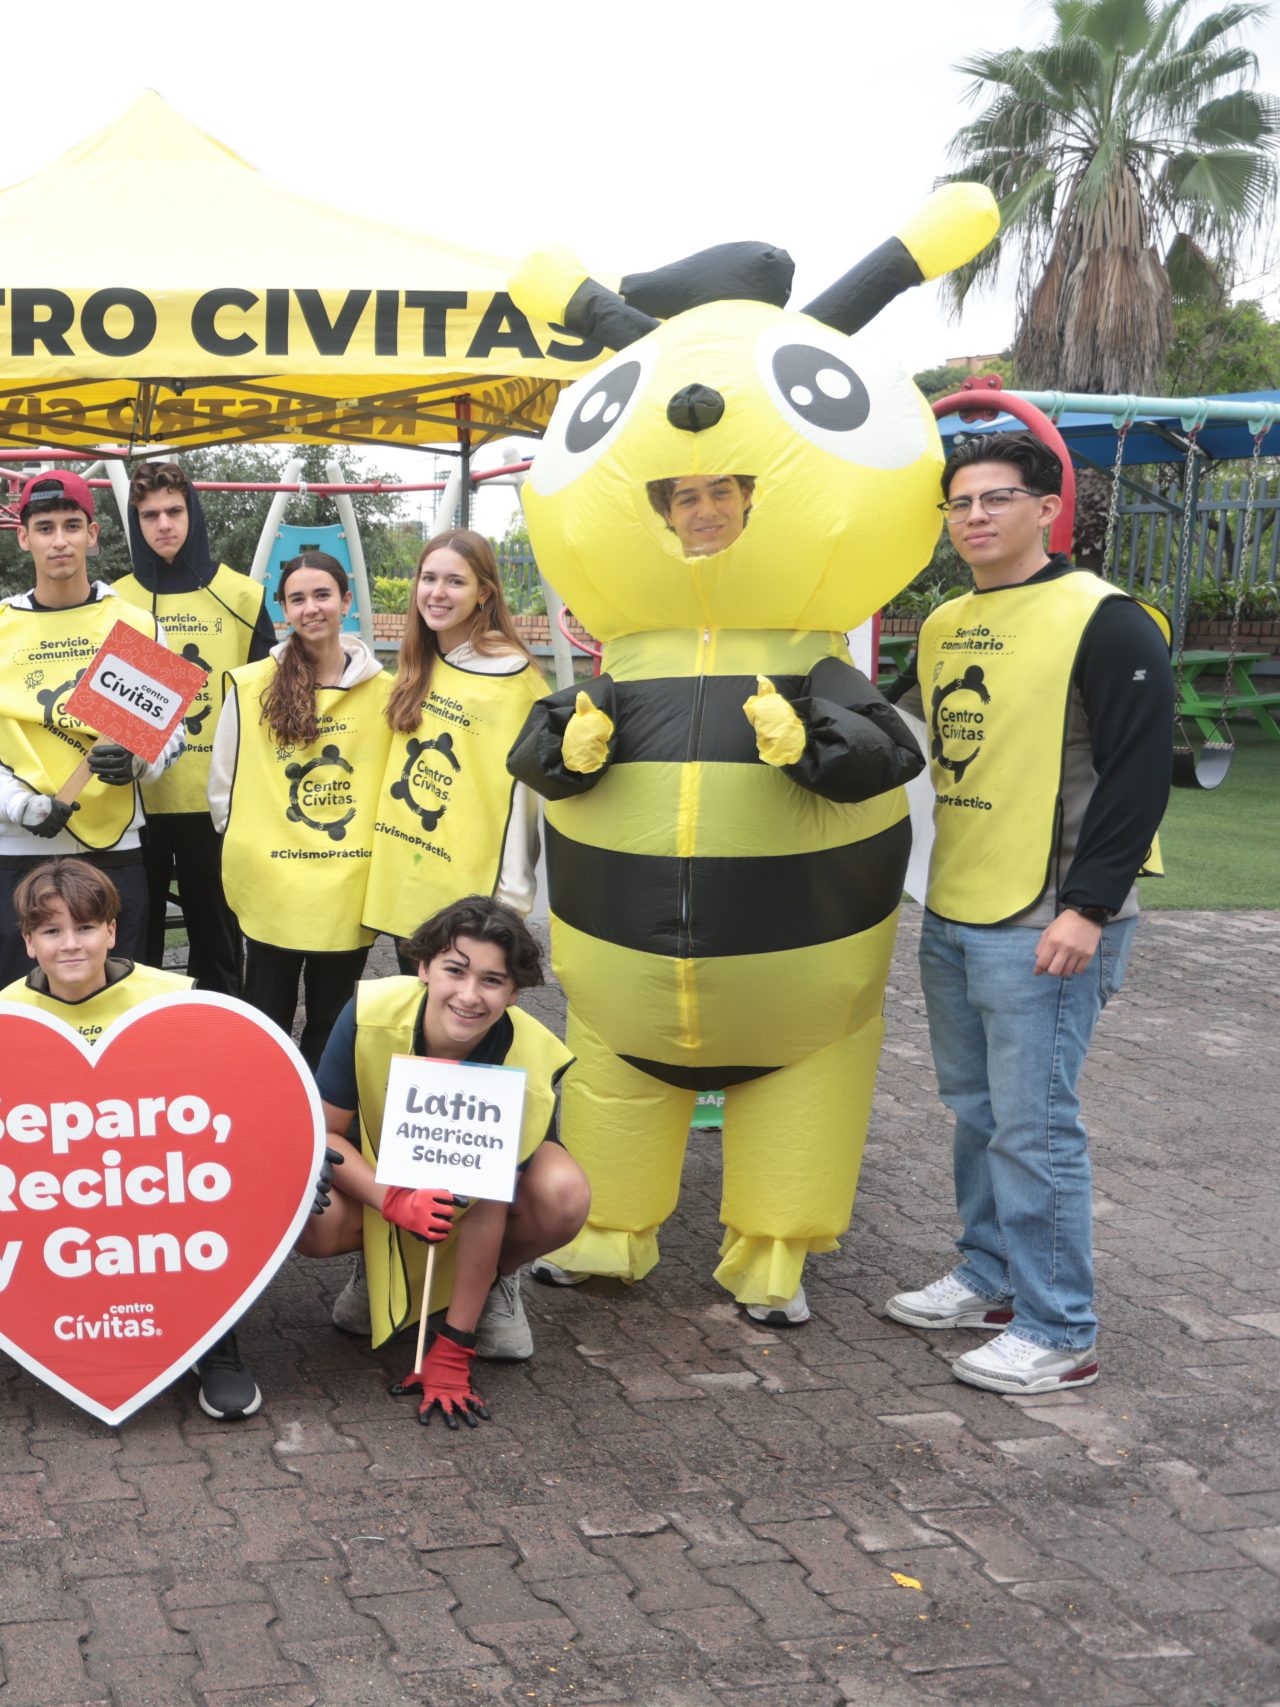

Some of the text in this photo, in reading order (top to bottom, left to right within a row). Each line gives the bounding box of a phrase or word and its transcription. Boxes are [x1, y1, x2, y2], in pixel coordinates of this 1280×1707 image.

[162, 623, 208, 634] unitario
[40, 637, 90, 650] Servicio
[99, 670, 164, 719] Cívitas
[141, 682, 170, 705] centro
[430, 691, 464, 712] Servicio
[420, 701, 471, 728] omunitario
[940, 707, 984, 723] Centro
[941, 723, 985, 742] Cívitas
[416, 760, 453, 786] Centro
[302, 780, 351, 793] Centro
[302, 791, 354, 806] Cívitas
[412, 772, 450, 801] Cívitas
[373, 821, 452, 863] CivismoPráctico
[405, 1085, 502, 1124] Latin
[396, 1121, 504, 1151] American
[411, 1145, 483, 1170] School
[43, 1226, 228, 1279] Gano
[109, 1302, 154, 1314] centro
[53, 1313, 156, 1341] Cívitas
